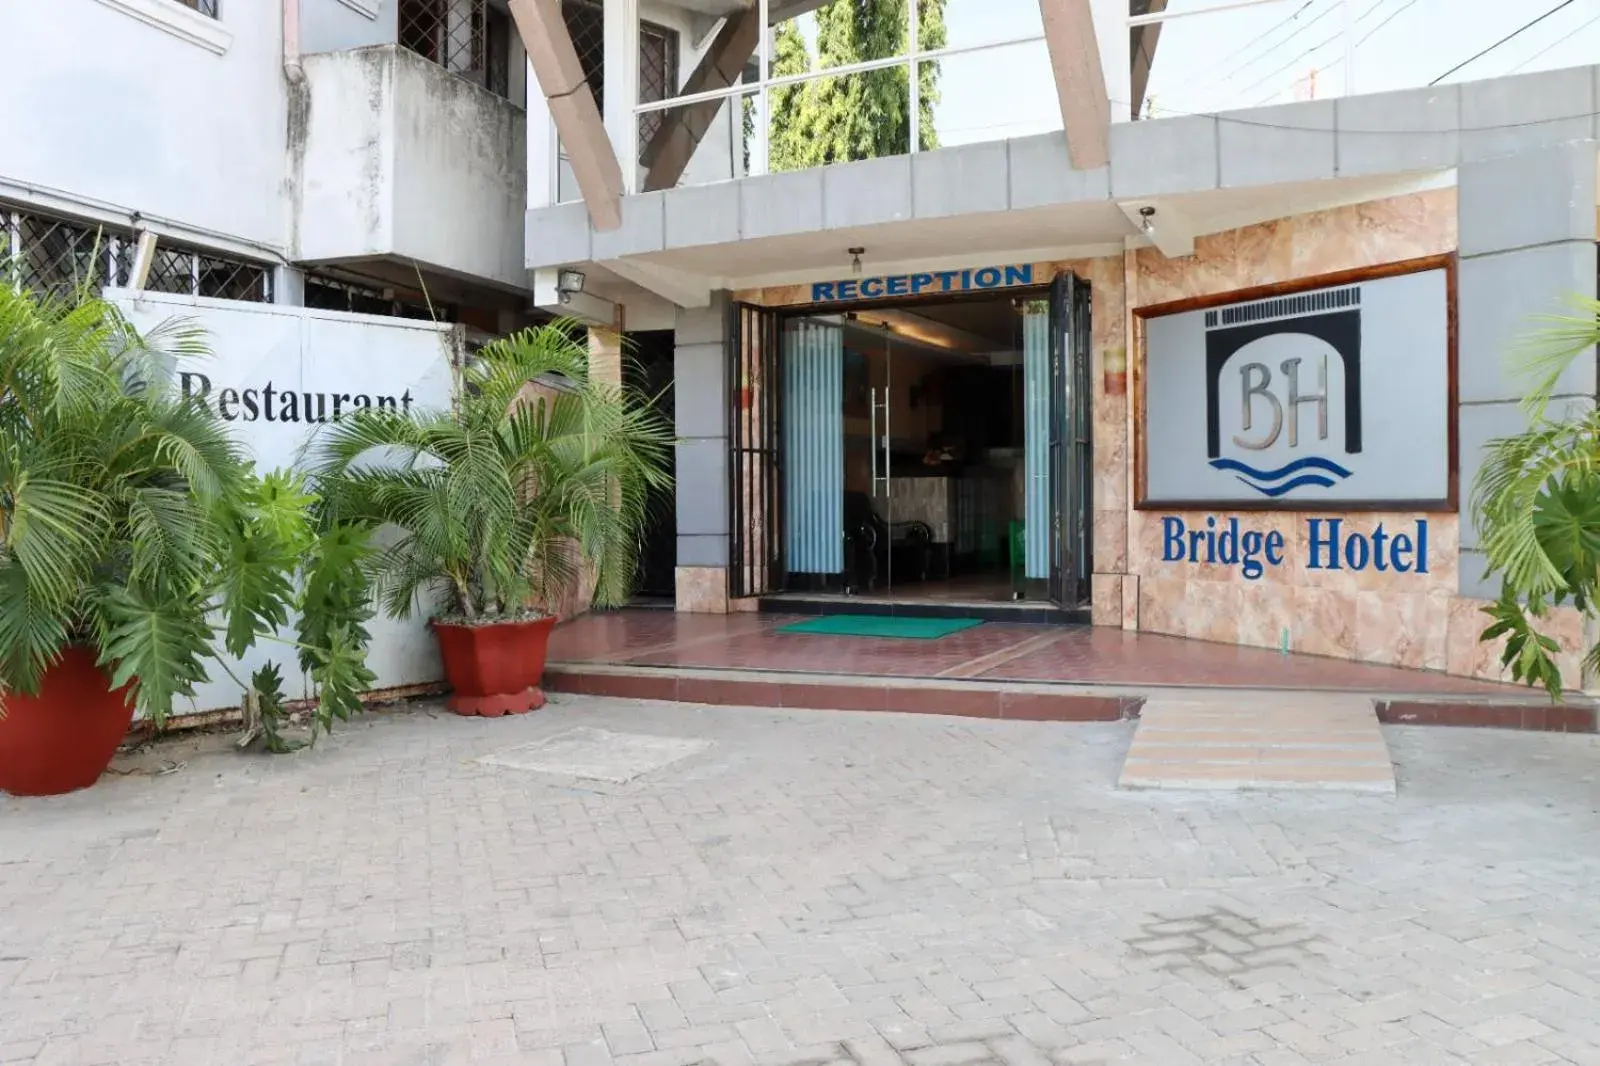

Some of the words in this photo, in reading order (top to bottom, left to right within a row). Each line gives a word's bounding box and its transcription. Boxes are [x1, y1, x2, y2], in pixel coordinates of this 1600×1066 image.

[812, 264, 1032, 302] RECEPTION
[176, 370, 415, 424] Restaurant
[1232, 354, 1329, 451] BH
[1161, 516, 1285, 580] Bridge
[1305, 518, 1430, 574] Hotel
